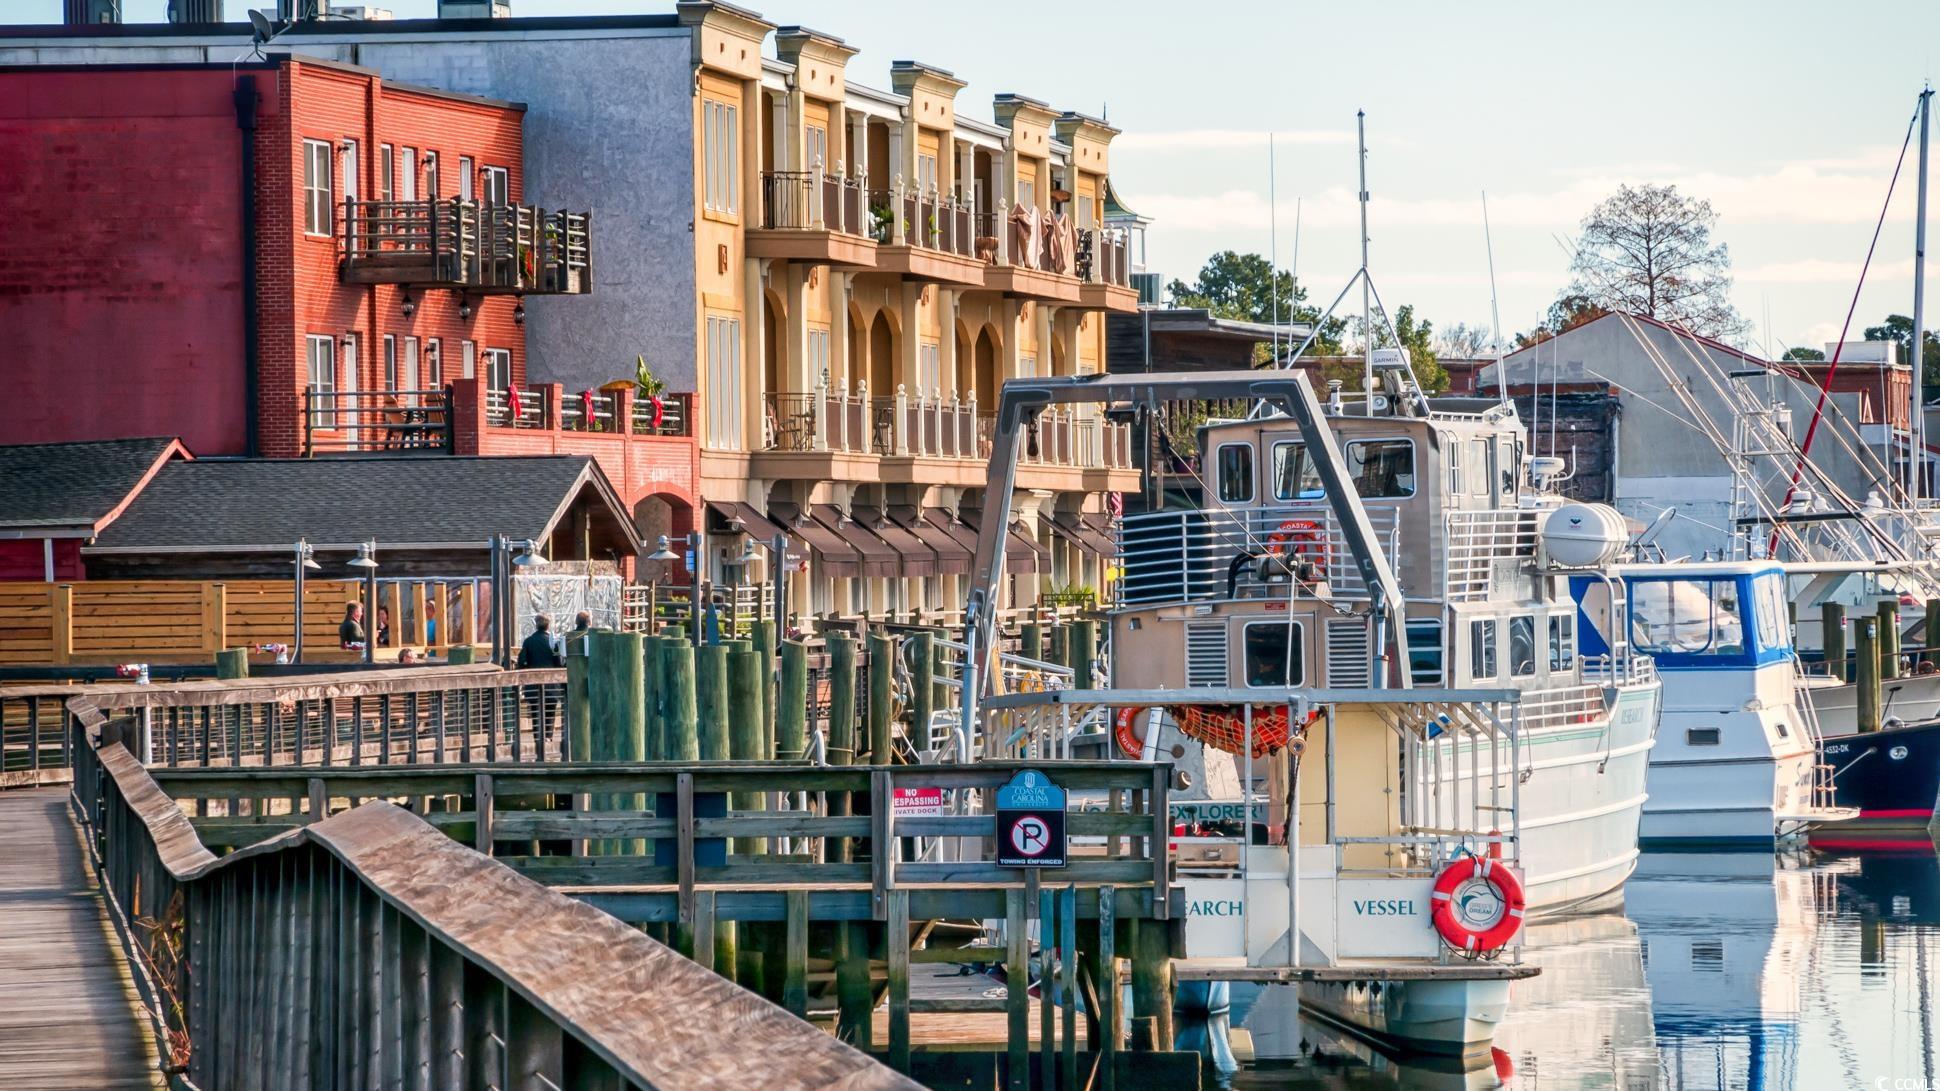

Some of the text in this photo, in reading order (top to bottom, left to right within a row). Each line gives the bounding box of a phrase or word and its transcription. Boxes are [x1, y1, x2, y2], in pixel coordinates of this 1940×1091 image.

[905, 788, 917, 797] NO
[1014, 787, 1046, 795] COASTAL
[894, 796, 940, 807] ESPASSING
[1011, 794, 1049, 802] CAROLINA
[1353, 899, 1418, 916] VESSEL
